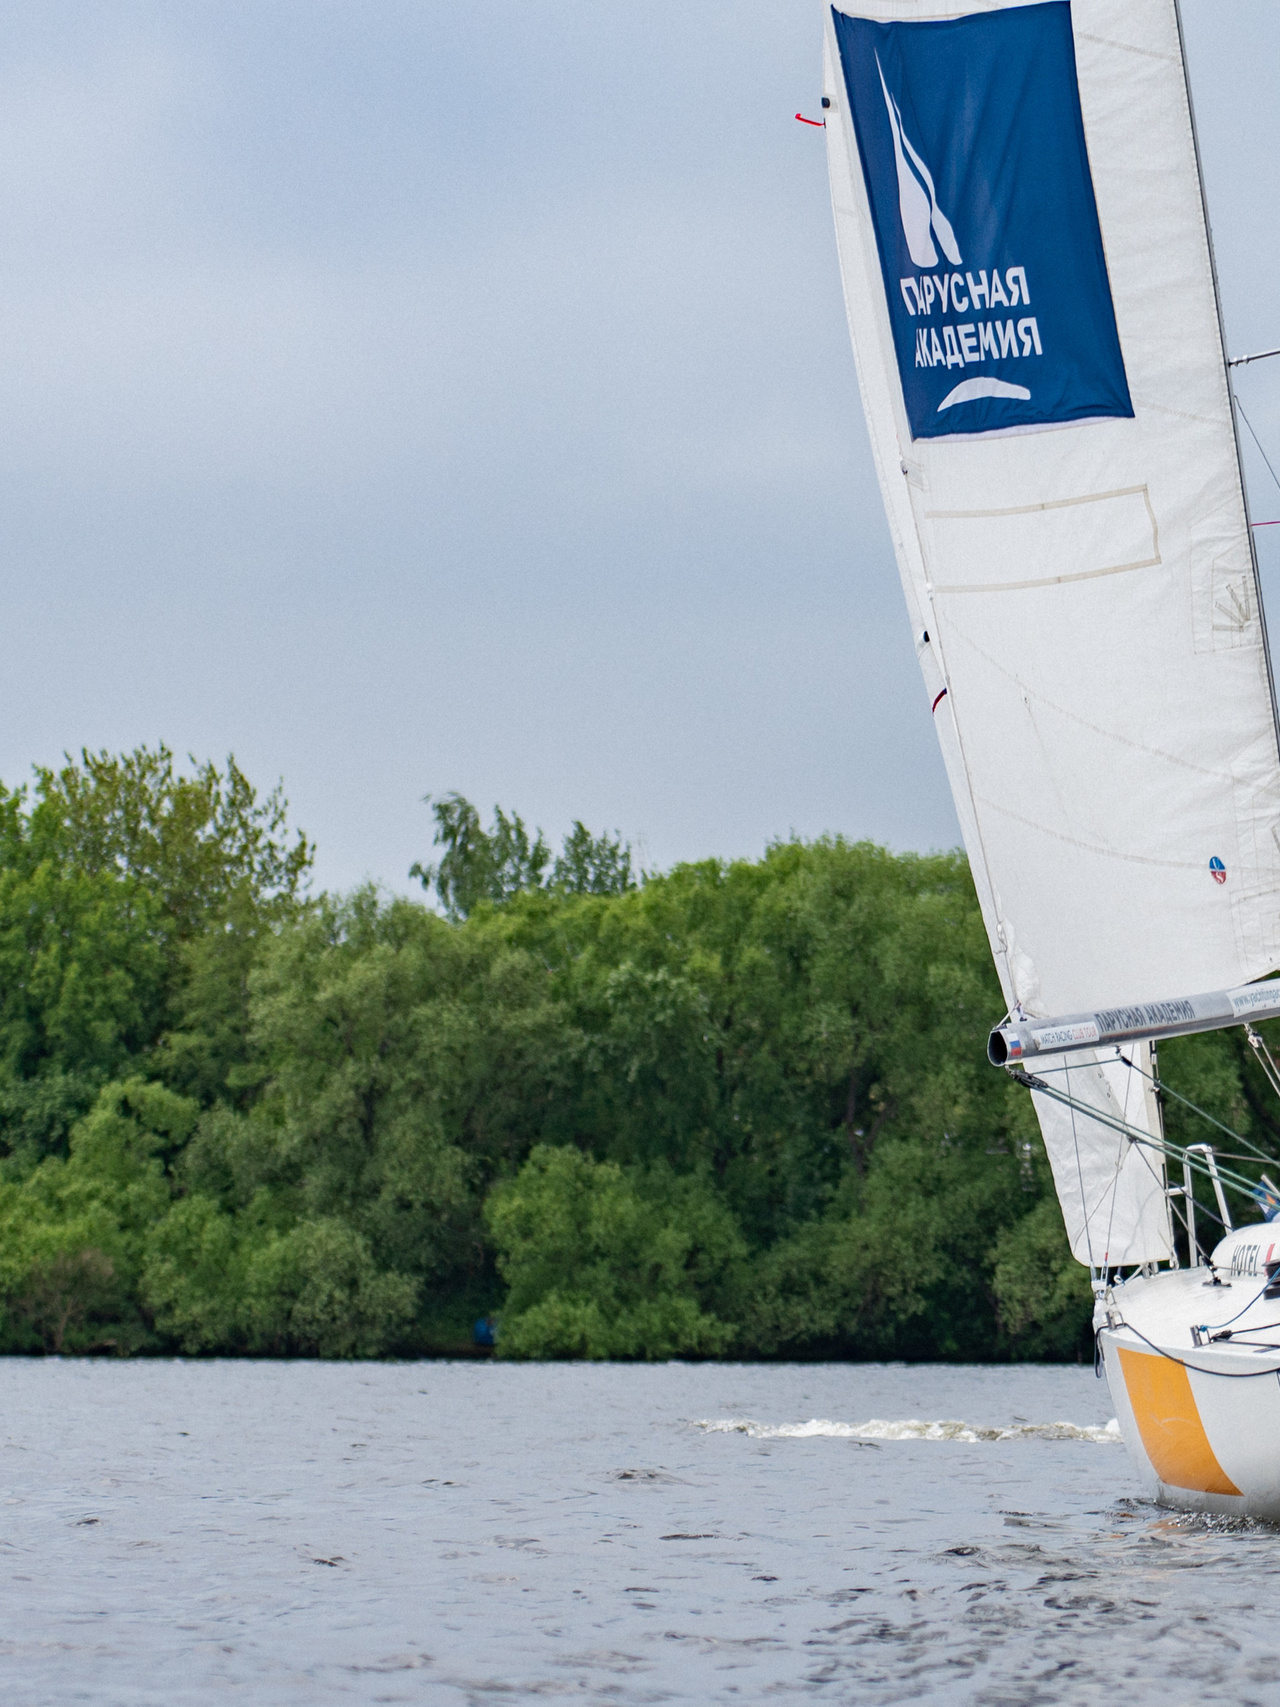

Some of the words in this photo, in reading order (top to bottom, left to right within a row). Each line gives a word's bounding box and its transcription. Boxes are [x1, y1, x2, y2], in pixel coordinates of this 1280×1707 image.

[900, 266, 1031, 316] ПАРУСНАЯ
[915, 317, 1043, 370] АКАДЕМИЯ
[1094, 1006, 1147, 1032] ПАРУСНАЯ
[1143, 1000, 1196, 1025] АКАДЕМИЯ
[1230, 1244, 1261, 1277] HOTEL
